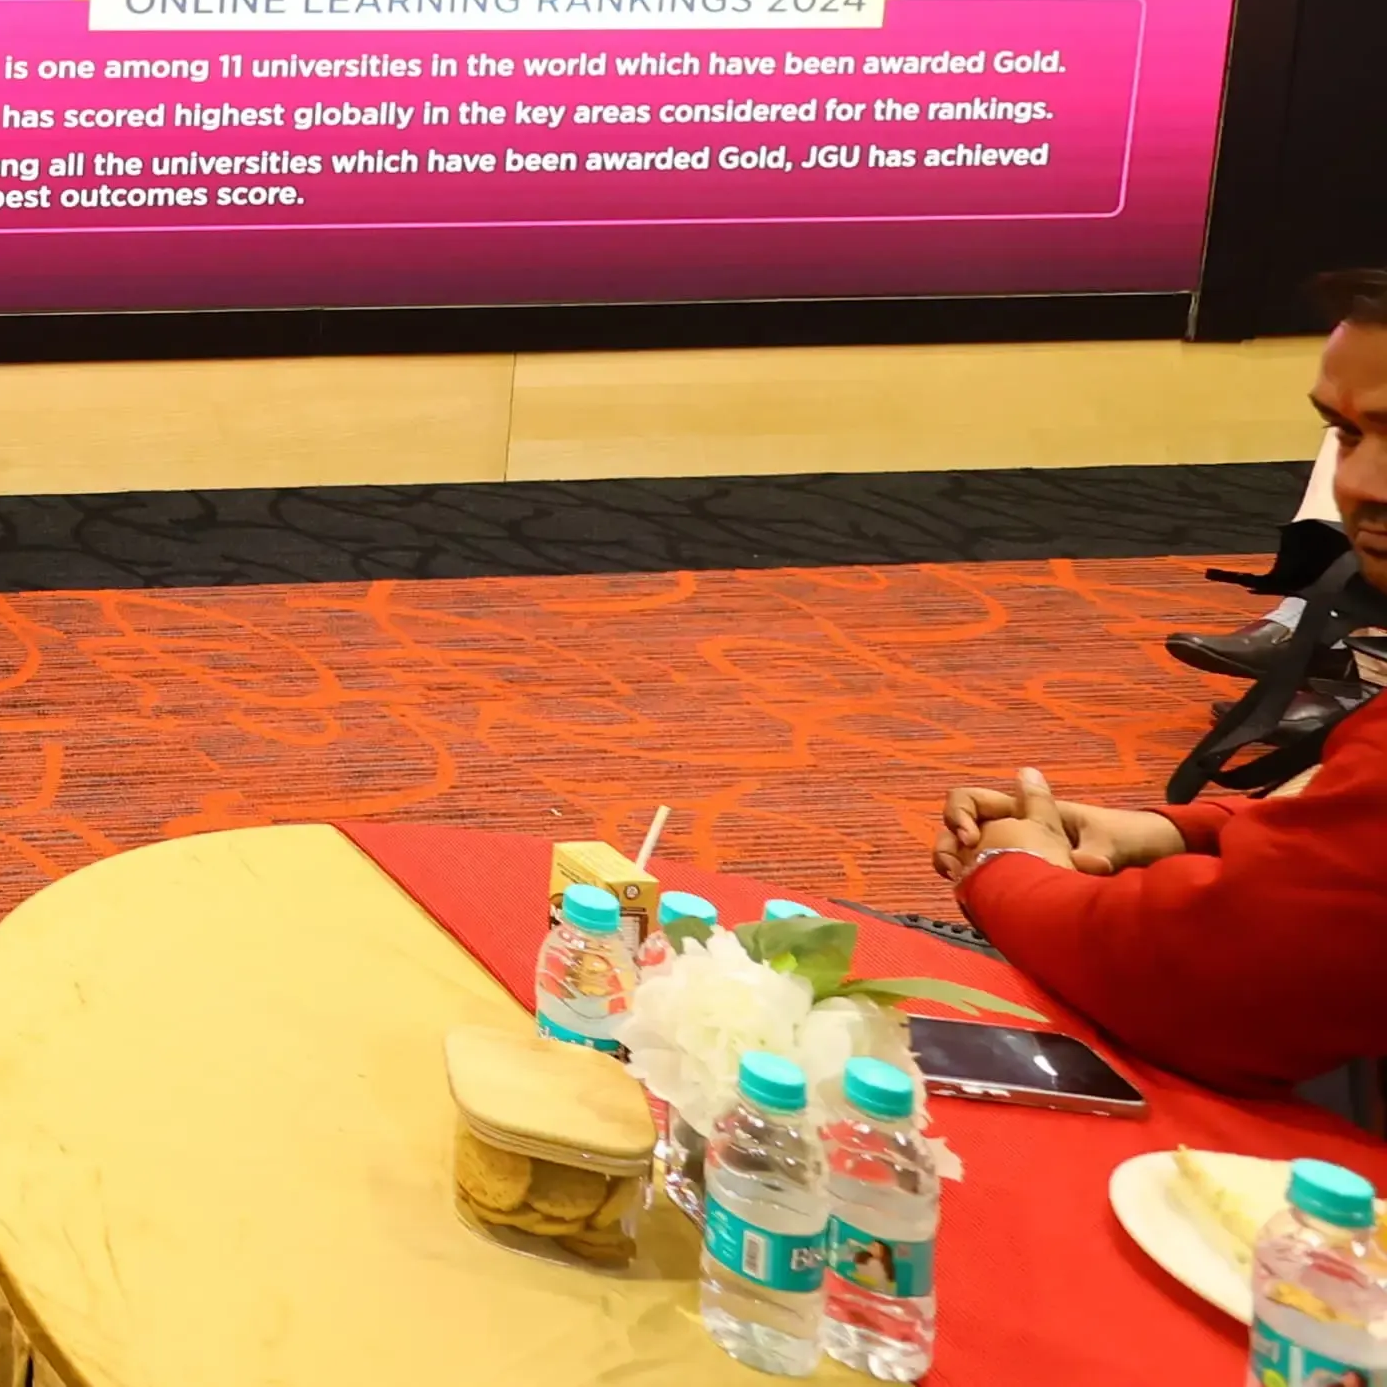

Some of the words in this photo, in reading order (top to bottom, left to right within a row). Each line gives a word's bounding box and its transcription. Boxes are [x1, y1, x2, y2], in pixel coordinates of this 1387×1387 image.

[5, 56, 28, 79] is
[38, 61, 95, 79] one
[104, 60, 209, 82] among
[219, 55, 242, 77] 11
[252, 54, 421, 77] universities
[432, 54, 457, 76] in
[467, 54, 514, 76] the
[524, 53, 606, 76] world
[616, 52, 699, 75] which
[709, 52, 775, 75] have
[785, 52, 855, 74] been
[863, 51, 985, 74] awarded
[994, 51, 1065, 73] Gold.
[3, 105, 54, 127] has
[64, 104, 164, 127] scored
[175, 103, 285, 130] highest
[294, 102, 414, 129] globally
[424, 102, 449, 124] in
[459, 102, 506, 124] the
[516, 101, 565, 127] key
[574, 105, 651, 123] areas
[659, 99, 817, 122] considered
[825, 98, 866, 121] for
[874, 98, 919, 120] the
[928, 98, 1053, 123] rankings.
[49, 153, 84, 176] all
[94, 153, 142, 175] the
[153, 151, 322, 175] universities
[332, 150, 418, 173] which
[428, 149, 496, 172] have
[506, 149, 577, 171] been
[586, 147, 709, 170] awarded
[719, 146, 792, 172] Gold,
[802, 146, 860, 168] JGU
[869, 145, 915, 167] has
[924, 143, 1048, 166] achieved
[61, 185, 207, 207] outcomes
[217, 187, 303, 205] score.
